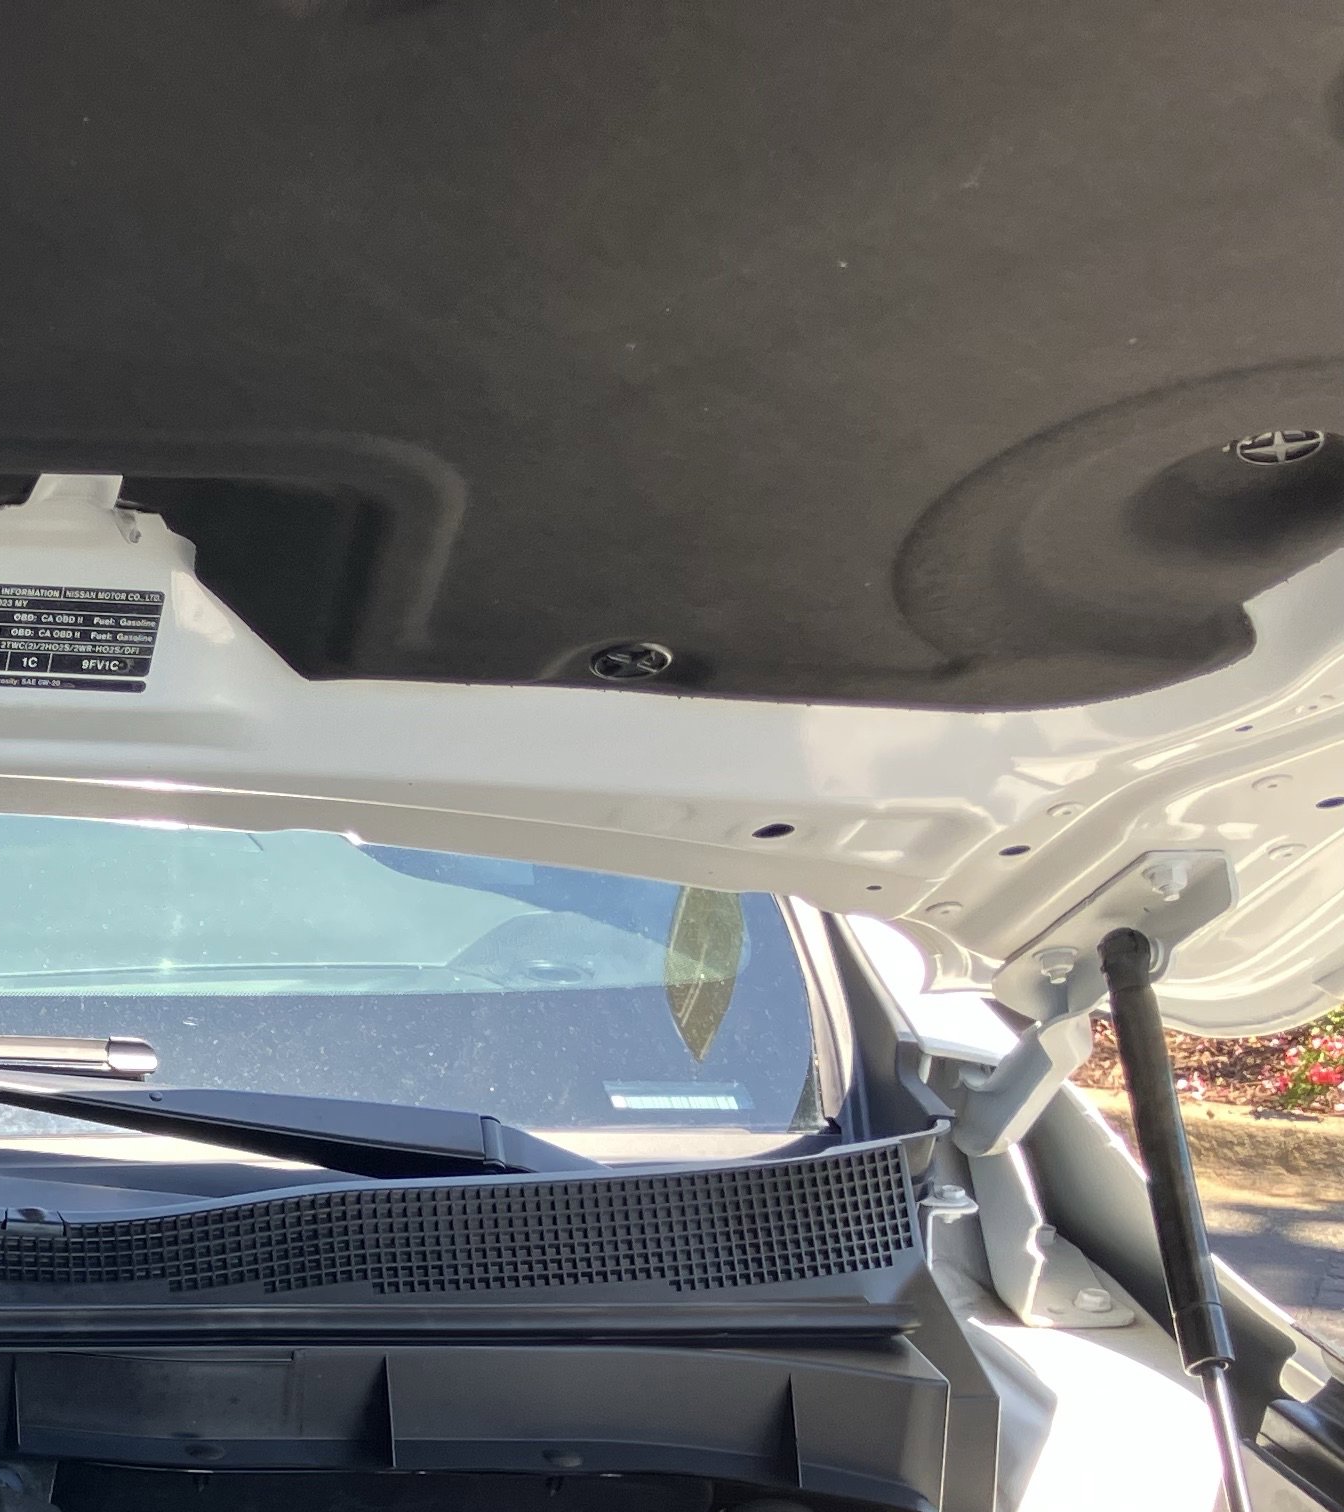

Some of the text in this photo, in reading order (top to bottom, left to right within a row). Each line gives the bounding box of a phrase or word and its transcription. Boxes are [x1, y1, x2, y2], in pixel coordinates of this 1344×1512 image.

[1, 586, 60, 598] INFORMATION
[65, 590, 96, 599] NISSAN
[97, 591, 127, 600] MOTOR
[13, 613, 37, 622] OBD:
[41, 615, 53, 623] CA
[55, 616, 76, 624] OBD
[93, 617, 115, 625] Fuel:
[120, 618, 156, 628] Gasoline
[11, 628, 34, 637] OBD:
[38, 629, 51, 638] CA
[53, 630, 72, 639] OBD
[90, 631, 113, 640] Fuel:
[116, 633, 152, 642] Gasoline
[22, 657, 38, 668] 1C
[21, 678, 36, 686] SAE
